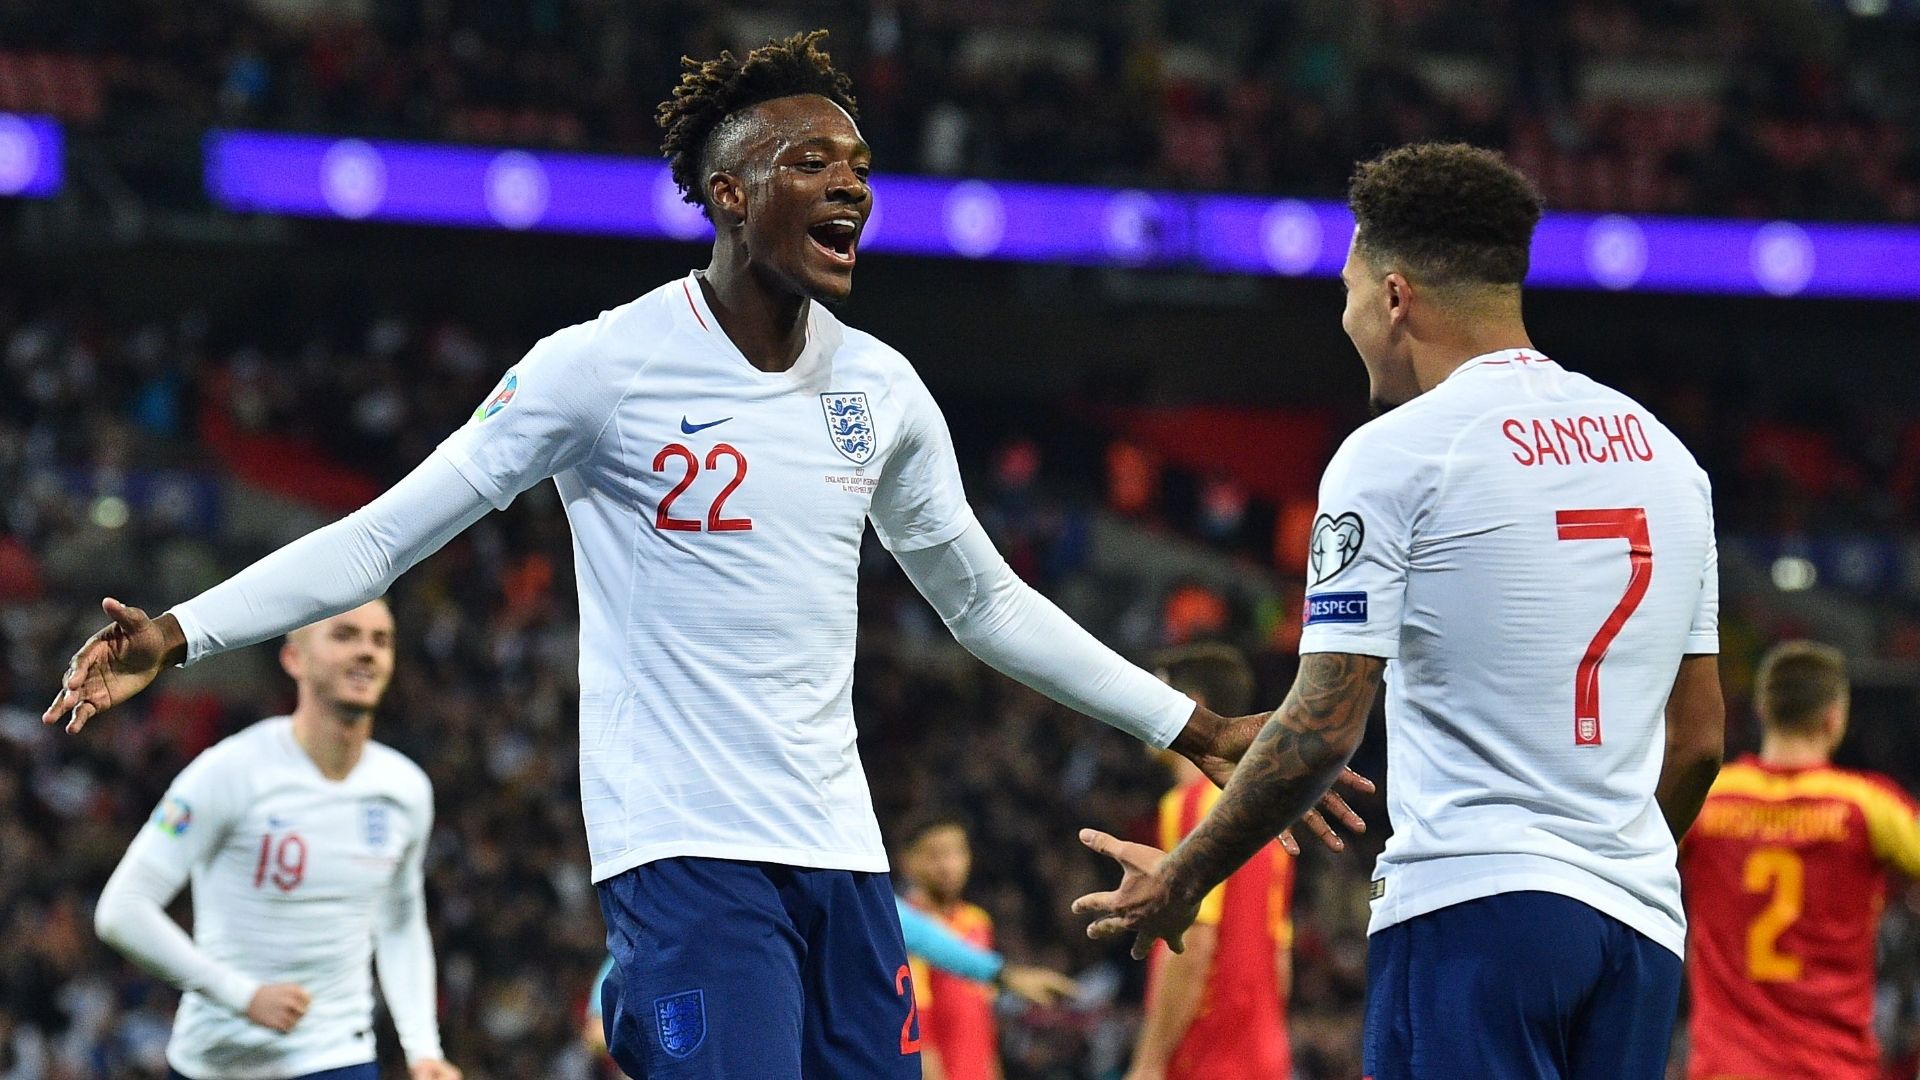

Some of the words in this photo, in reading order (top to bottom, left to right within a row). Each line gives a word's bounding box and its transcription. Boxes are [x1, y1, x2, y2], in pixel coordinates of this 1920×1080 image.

[1503, 414, 1653, 466] SANCHO
[652, 443, 752, 531] 22
[1311, 600, 1367, 616] RESPECT
[1556, 508, 1653, 746] 7
[254, 833, 308, 891] 19
[1742, 848, 1804, 982] 2
